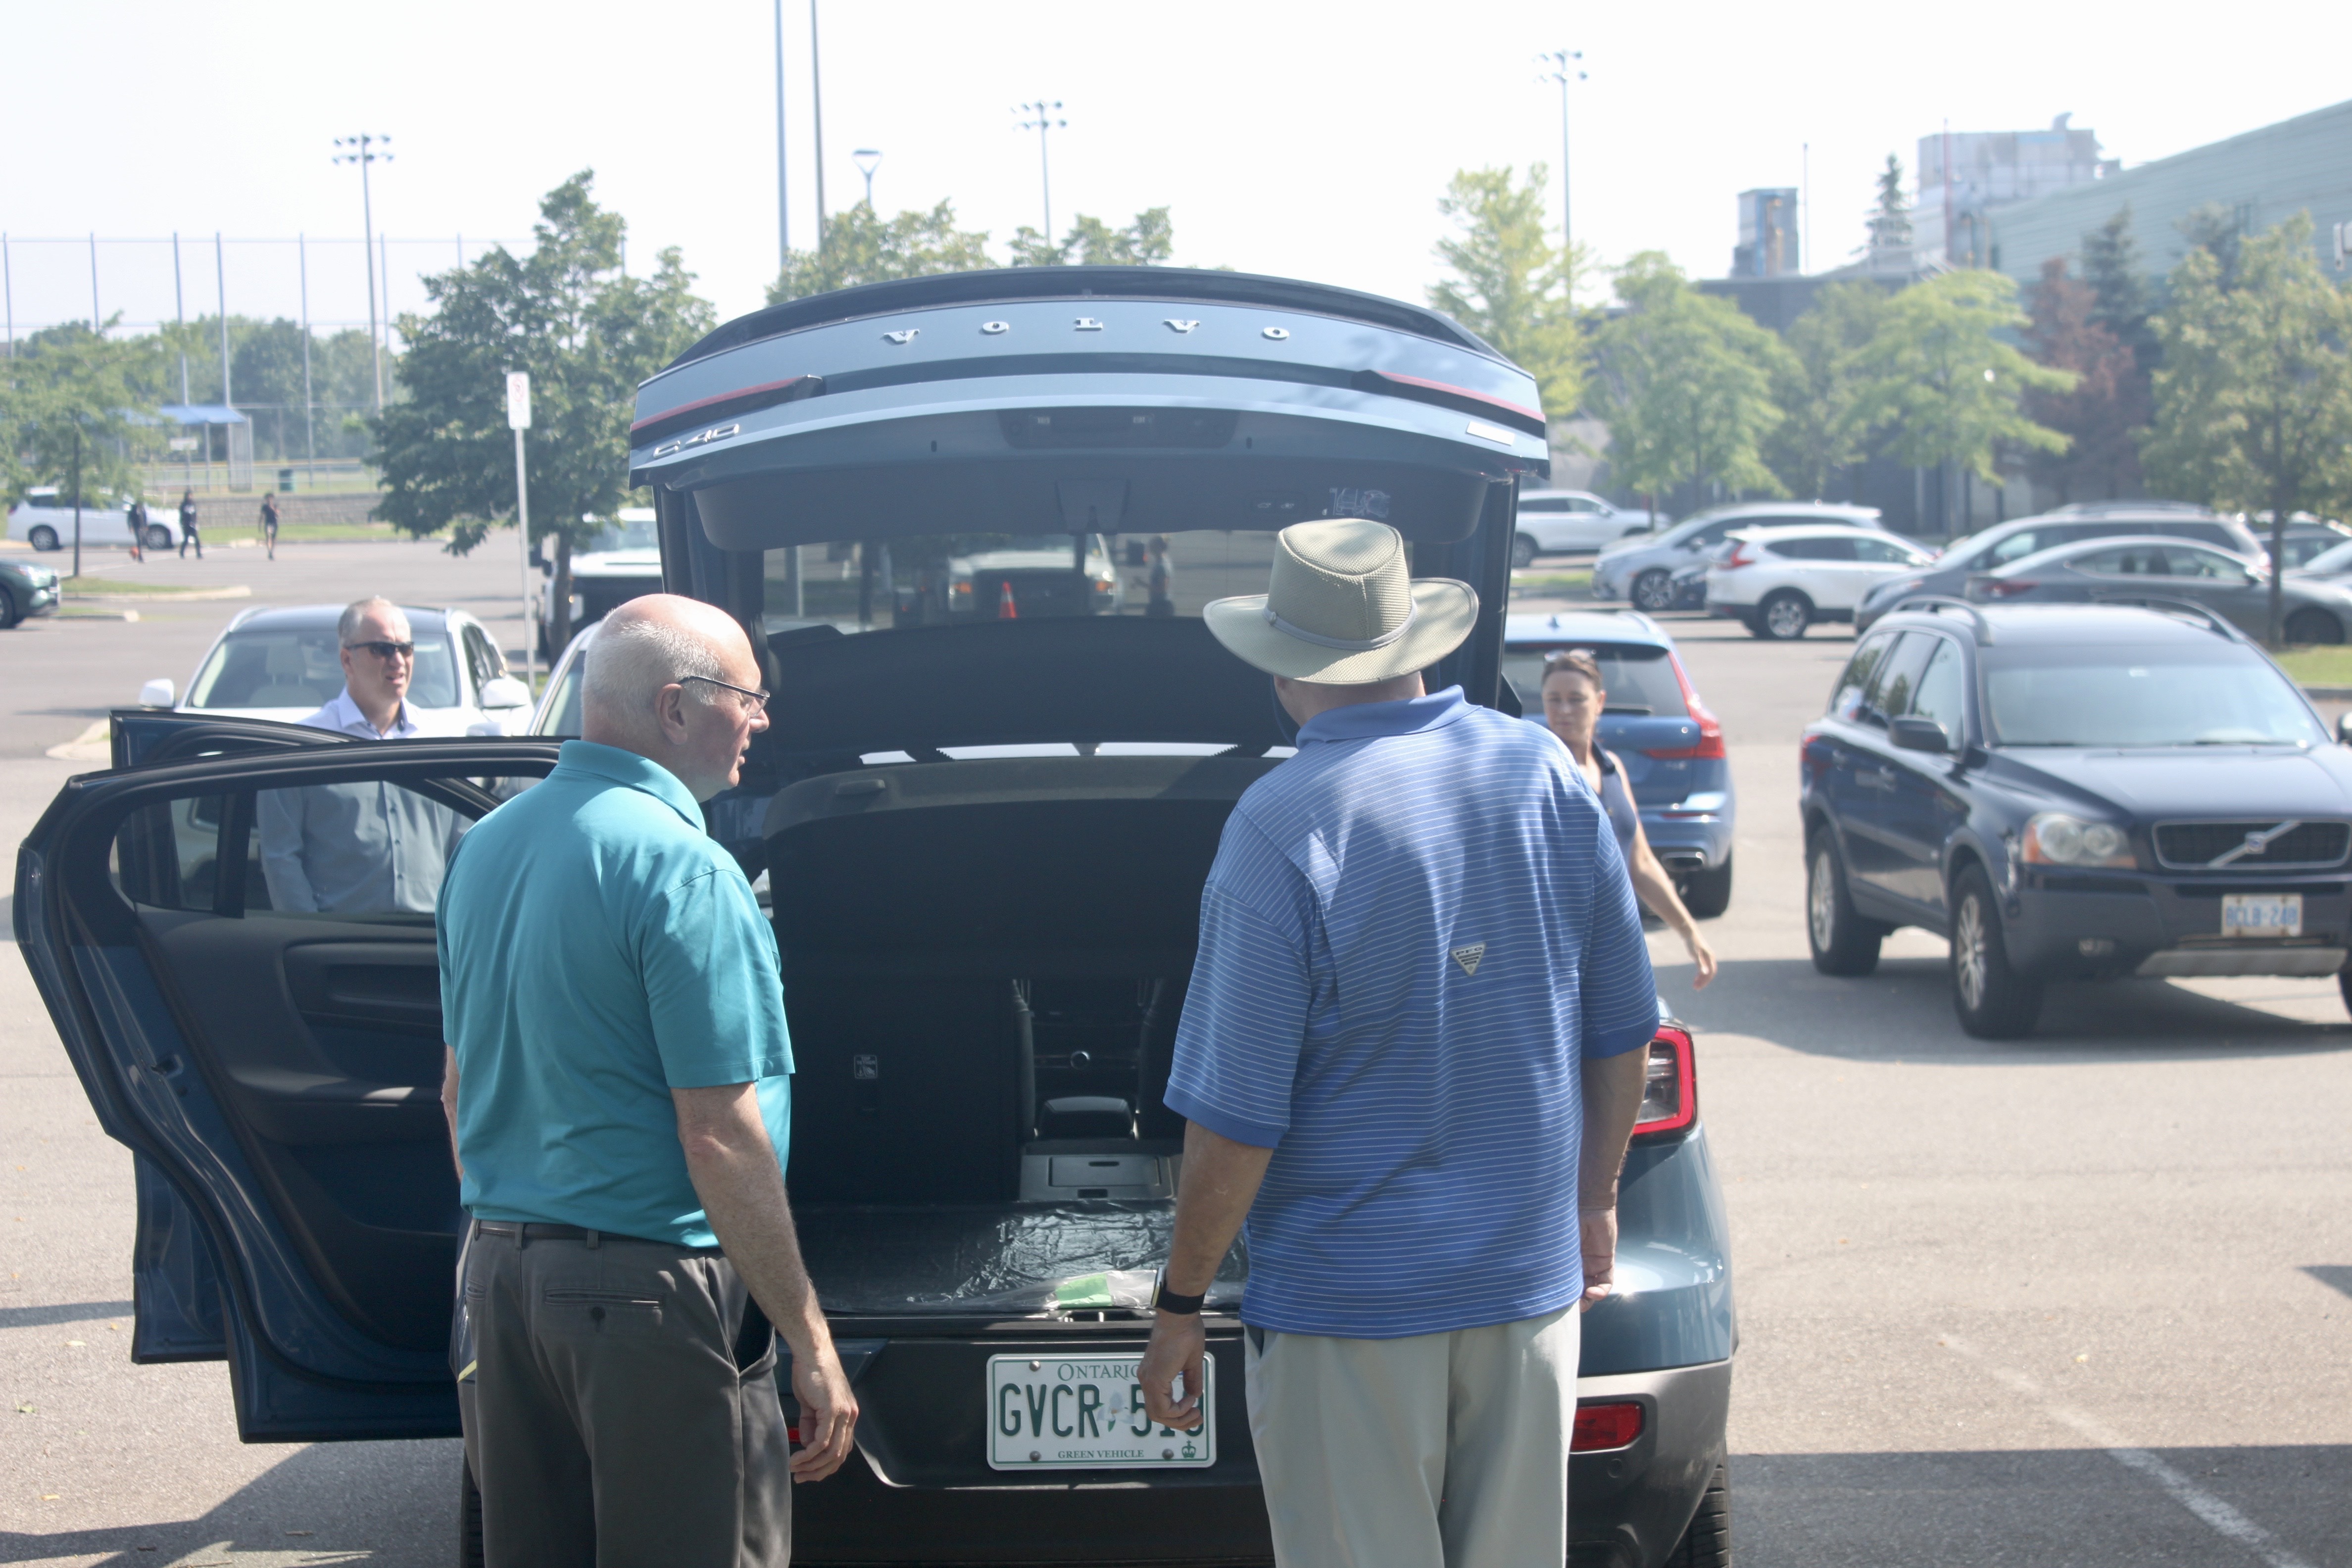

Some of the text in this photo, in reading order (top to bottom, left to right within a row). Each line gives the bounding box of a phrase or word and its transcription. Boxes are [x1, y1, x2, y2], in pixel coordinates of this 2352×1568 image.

[883, 317, 1289, 344] VOLVO
[653, 423, 739, 459] C40
[999, 1383, 1100, 1437] GVCR
[1058, 1450, 1144, 1459] GREEN VEHICLE
